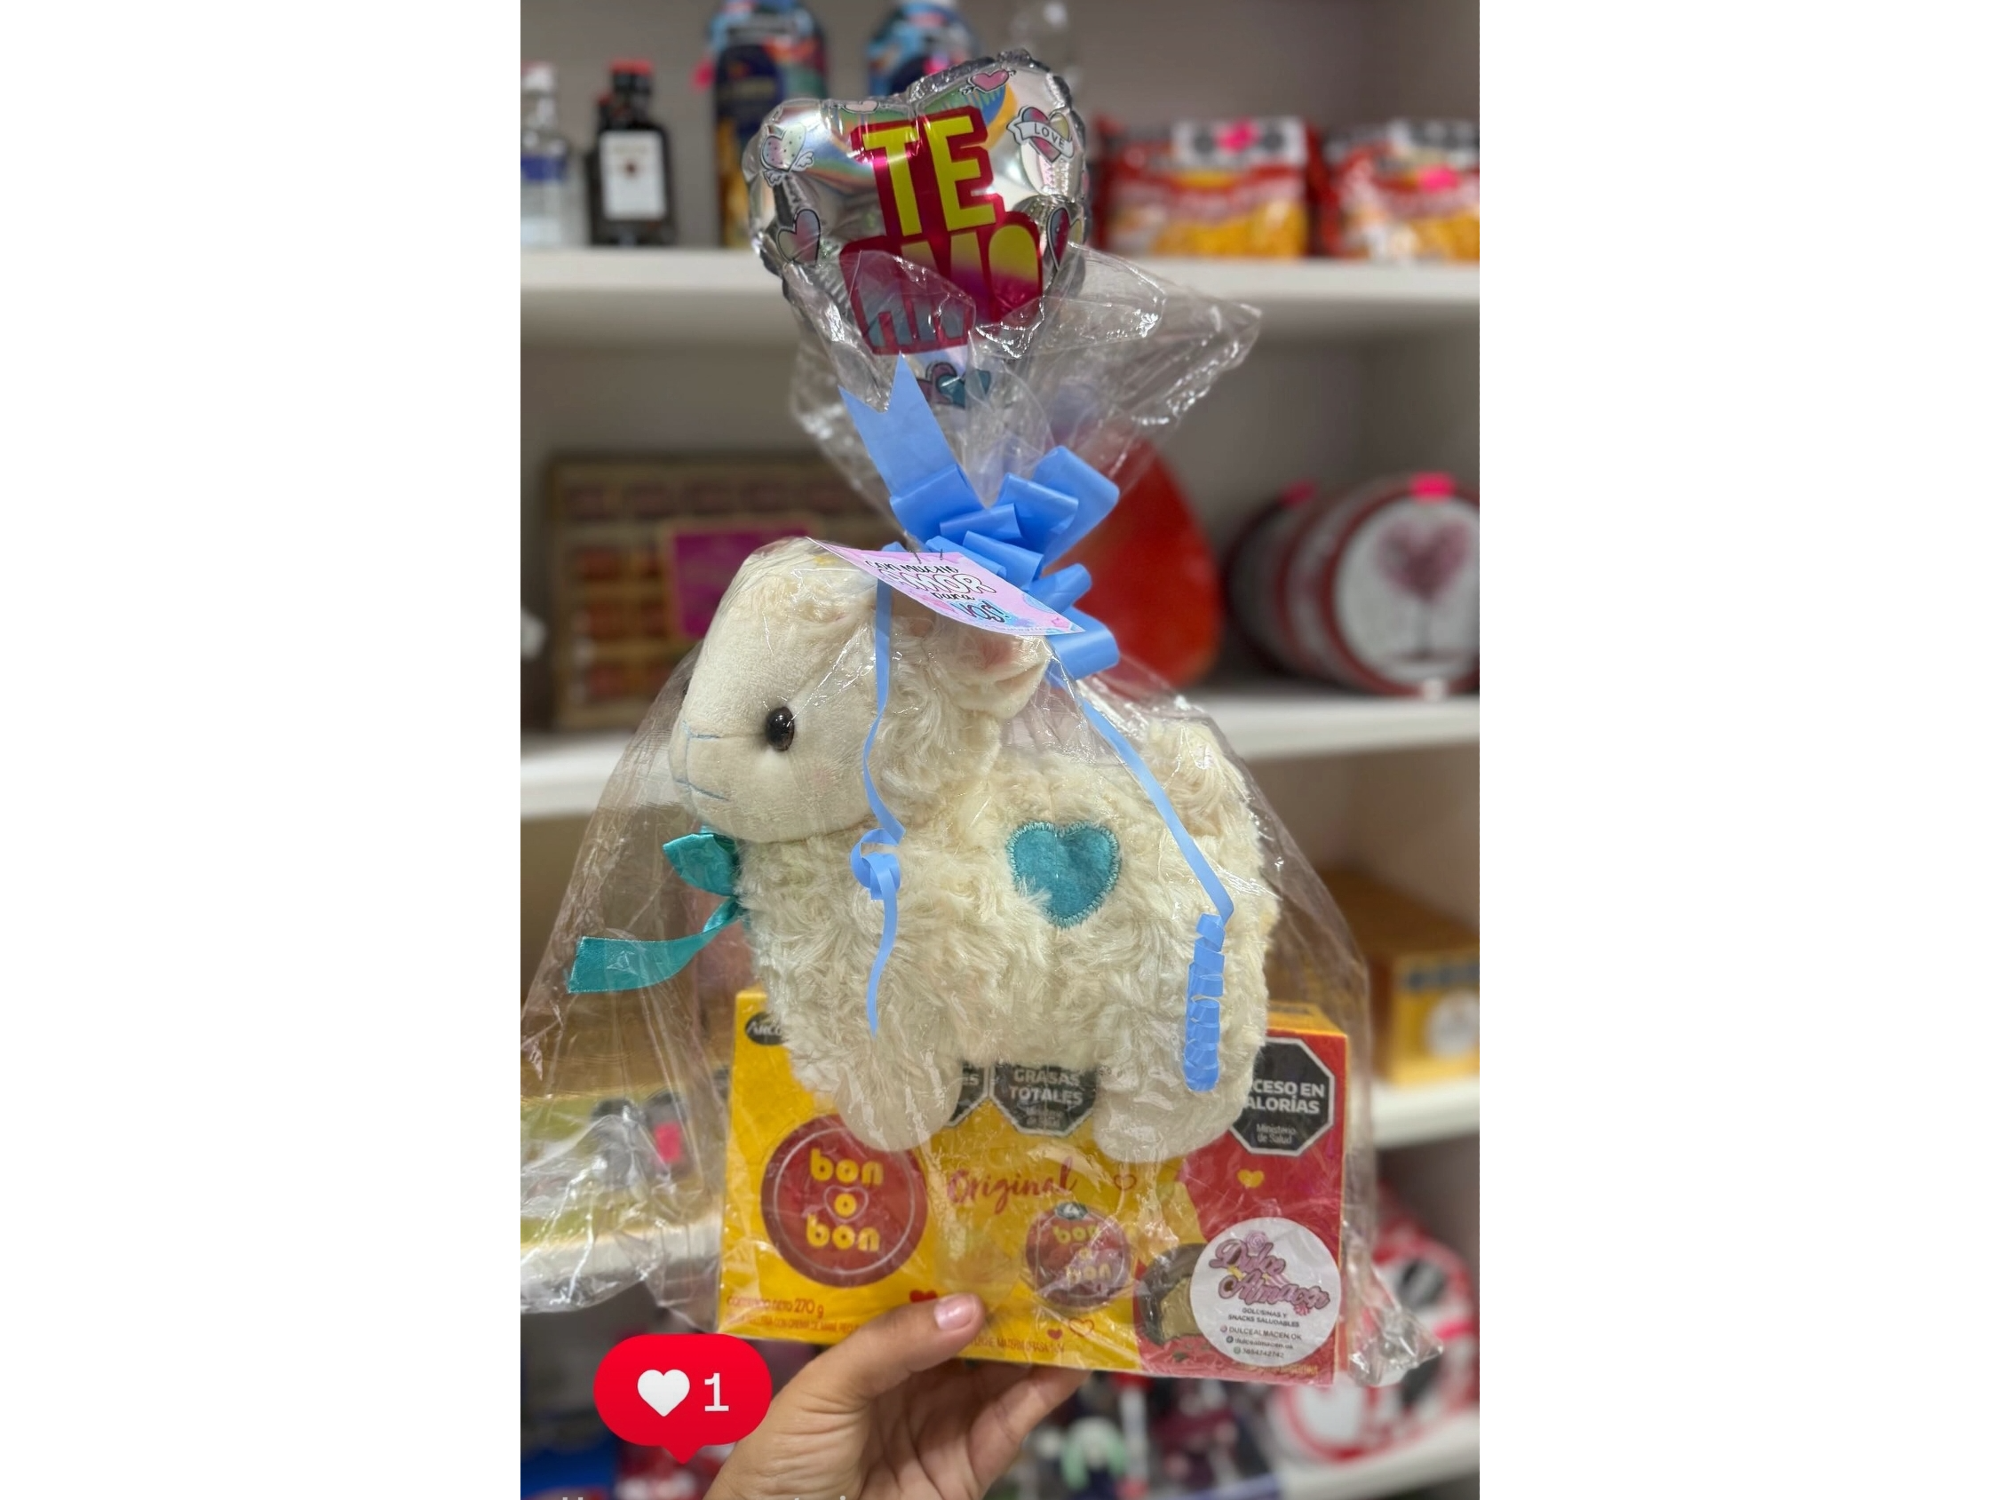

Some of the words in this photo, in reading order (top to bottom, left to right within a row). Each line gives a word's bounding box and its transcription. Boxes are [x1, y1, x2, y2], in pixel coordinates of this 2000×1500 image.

[1033, 122, 1066, 149] LOVE
[862, 115, 997, 237] TE
[879, 568, 997, 594] AMOR
[1013, 1067, 1081, 1088] GRASAS
[1252, 1079, 1299, 1095] CESO
[1300, 1082, 1325, 1098] EN
[1009, 1085, 1084, 1107] TOTALES
[1245, 1095, 1321, 1114] ALORÍAS
[1256, 1123, 1297, 1136] Ministerio
[1257, 1133, 1268, 1143] de
[1269, 1134, 1293, 1145] Salud
[809, 1148, 884, 1187] bon
[947, 1156, 1078, 1215] Original
[806, 1213, 880, 1252] bon
[1052, 1225, 1099, 1245] bon
[1209, 1239, 1287, 1276] Dulce
[1066, 1263, 1112, 1285] bon
[794, 1298, 815, 1314] 270
[816, 1304, 825, 1320] g
[1228, 1314, 1256, 1323] SNACKS
[1256, 1316, 1300, 1328] SALUDABLES
